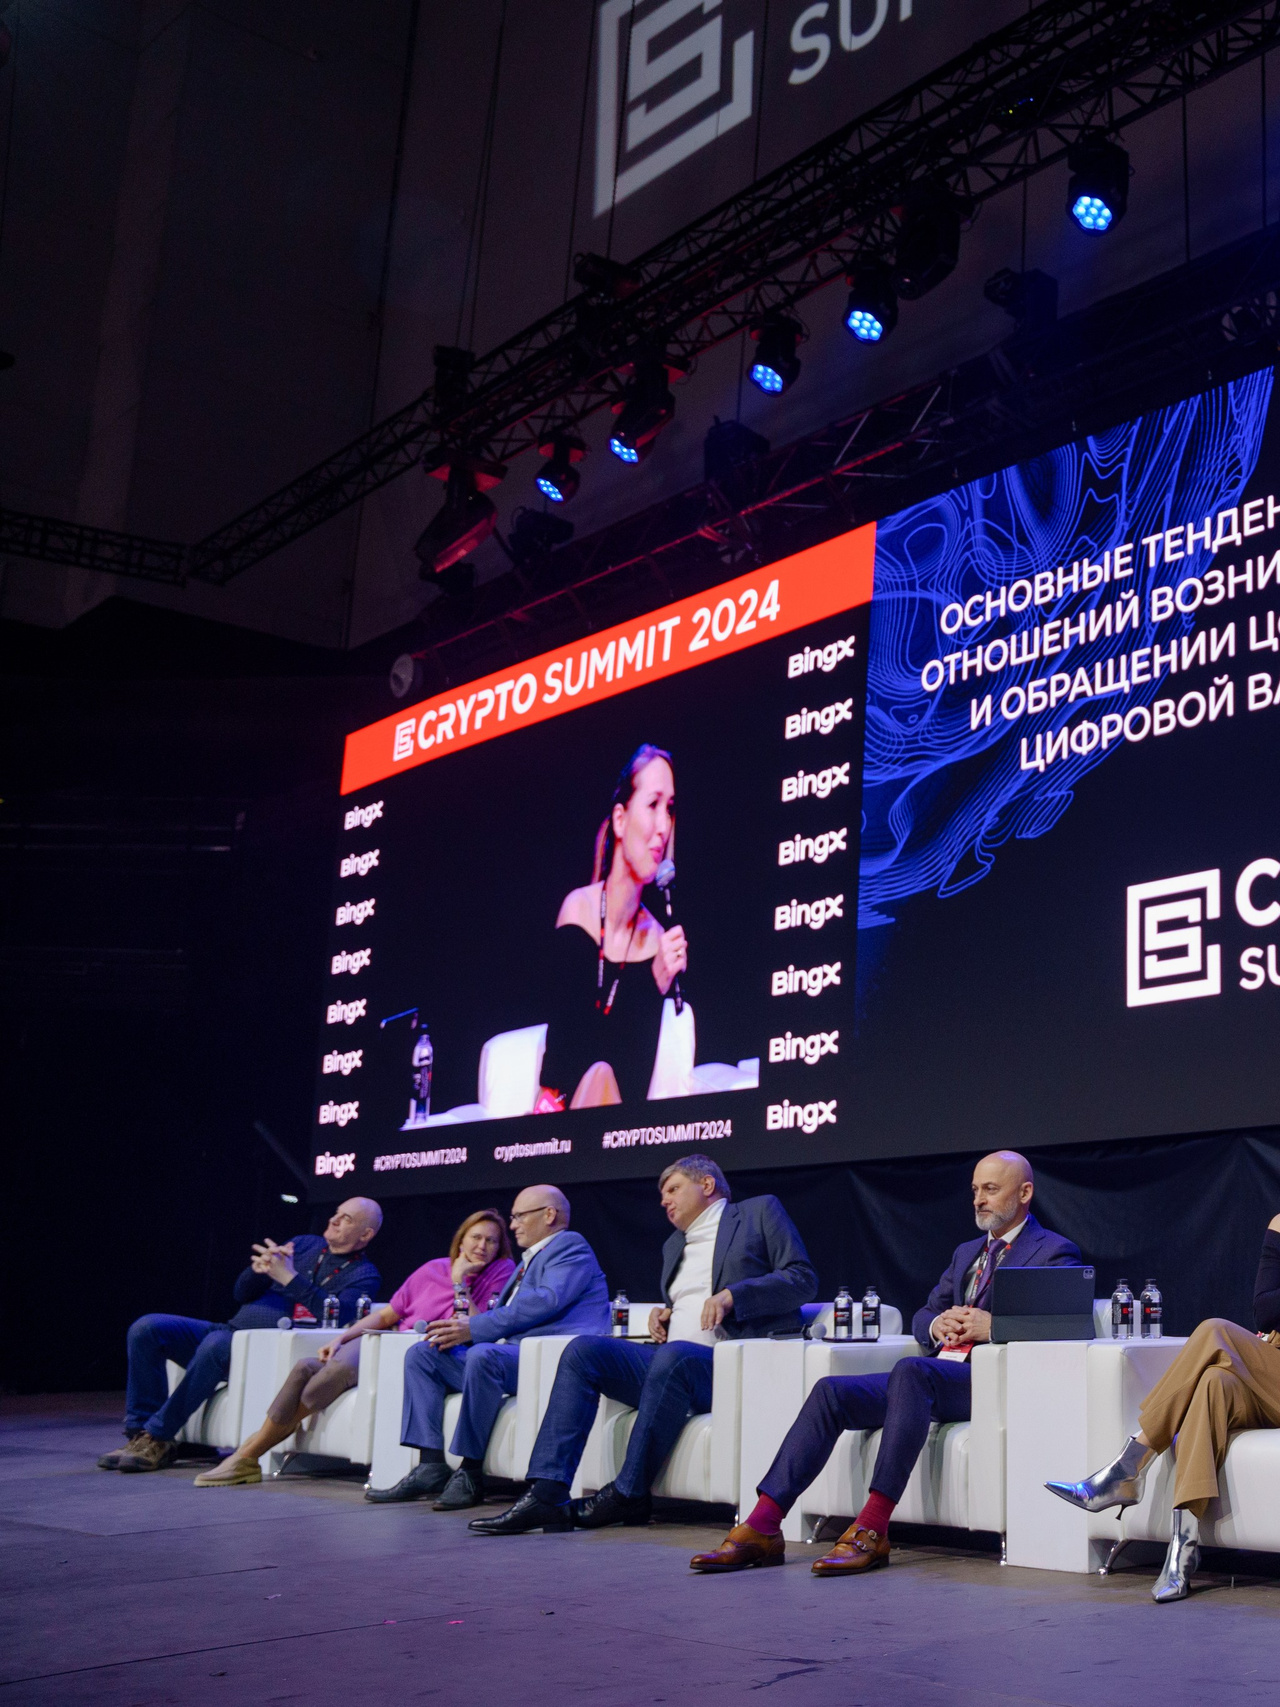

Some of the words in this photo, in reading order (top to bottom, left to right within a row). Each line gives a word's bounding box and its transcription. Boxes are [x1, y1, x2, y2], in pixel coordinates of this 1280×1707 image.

[787, 0, 913, 86] SU
[940, 542, 1134, 635] ОСНОВНЫЕ
[417, 672, 538, 750] CRYPTO
[542, 615, 681, 704] SUMMIT
[688, 579, 781, 652] 2024
[920, 588, 1139, 692] ОТНОШЕНИЙ
[970, 694, 992, 731] И
[1000, 621, 1236, 720] ОБРАЩЕНИИ
[1020, 674, 1234, 773] ЦИФРОВОЙ
[373, 1146, 468, 1172] #CRYPTOSUMMIT2024
[493, 1137, 572, 1163] cryptosummit.ru
[601, 1118, 733, 1149] #CRYPTOSUMMIT2024
